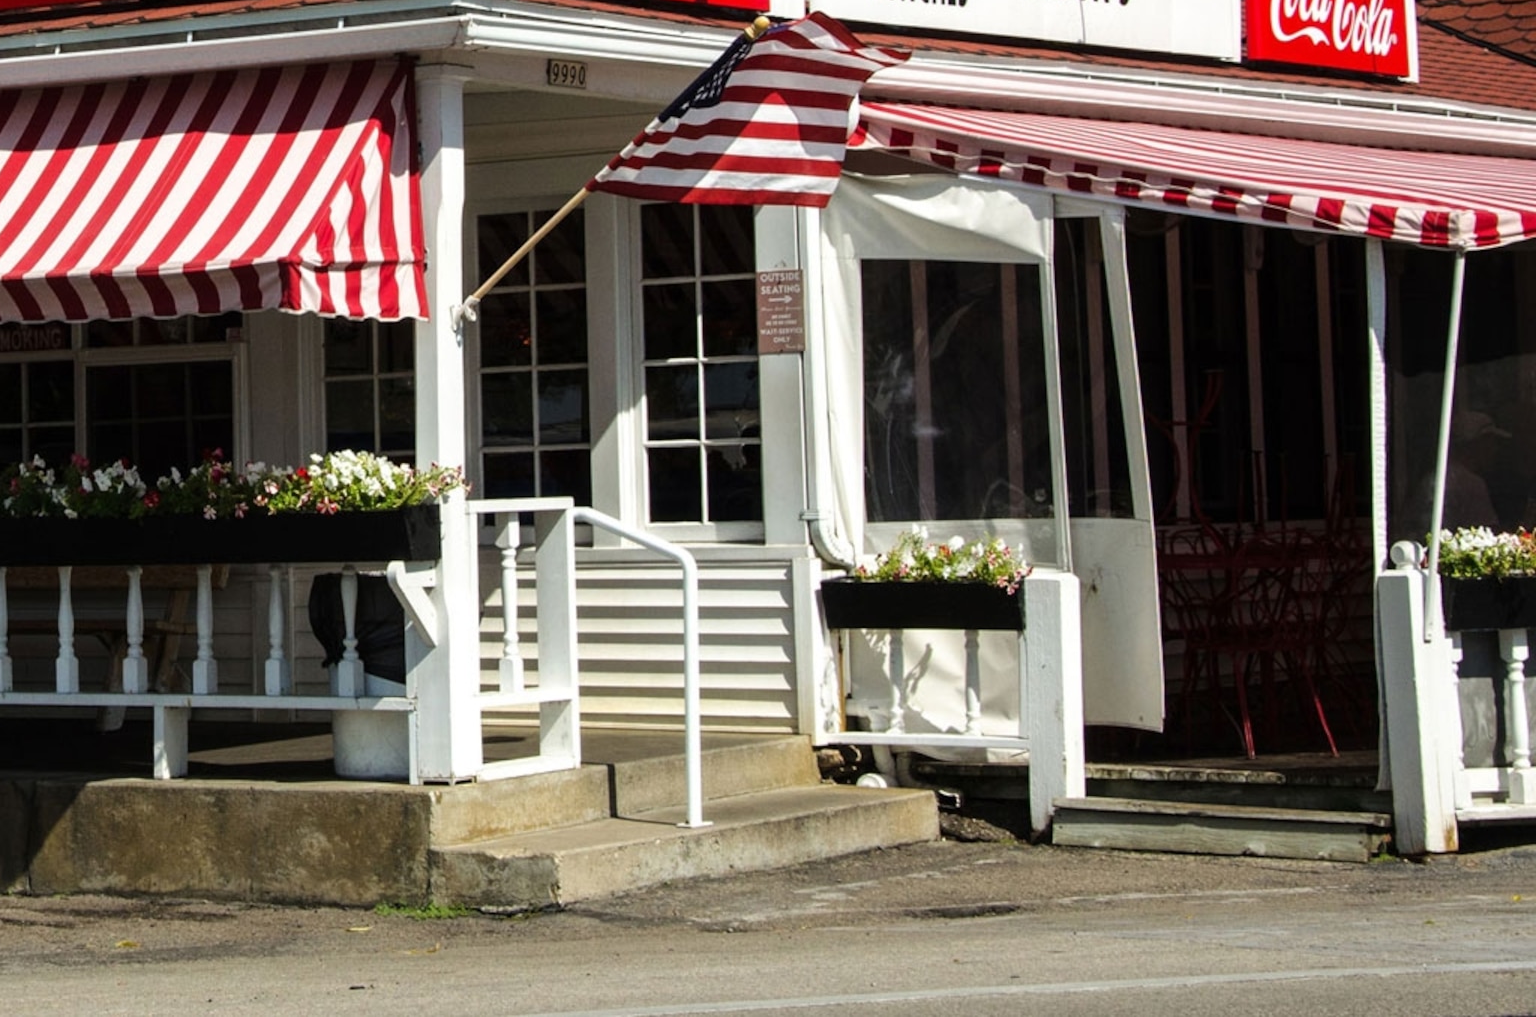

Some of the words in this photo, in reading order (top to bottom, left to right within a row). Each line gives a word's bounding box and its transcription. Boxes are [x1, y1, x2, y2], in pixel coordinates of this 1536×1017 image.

[551, 62, 587, 85] 9990
[759, 272, 800, 283] OUTSIDE
[760, 284, 801, 295] SEATING
